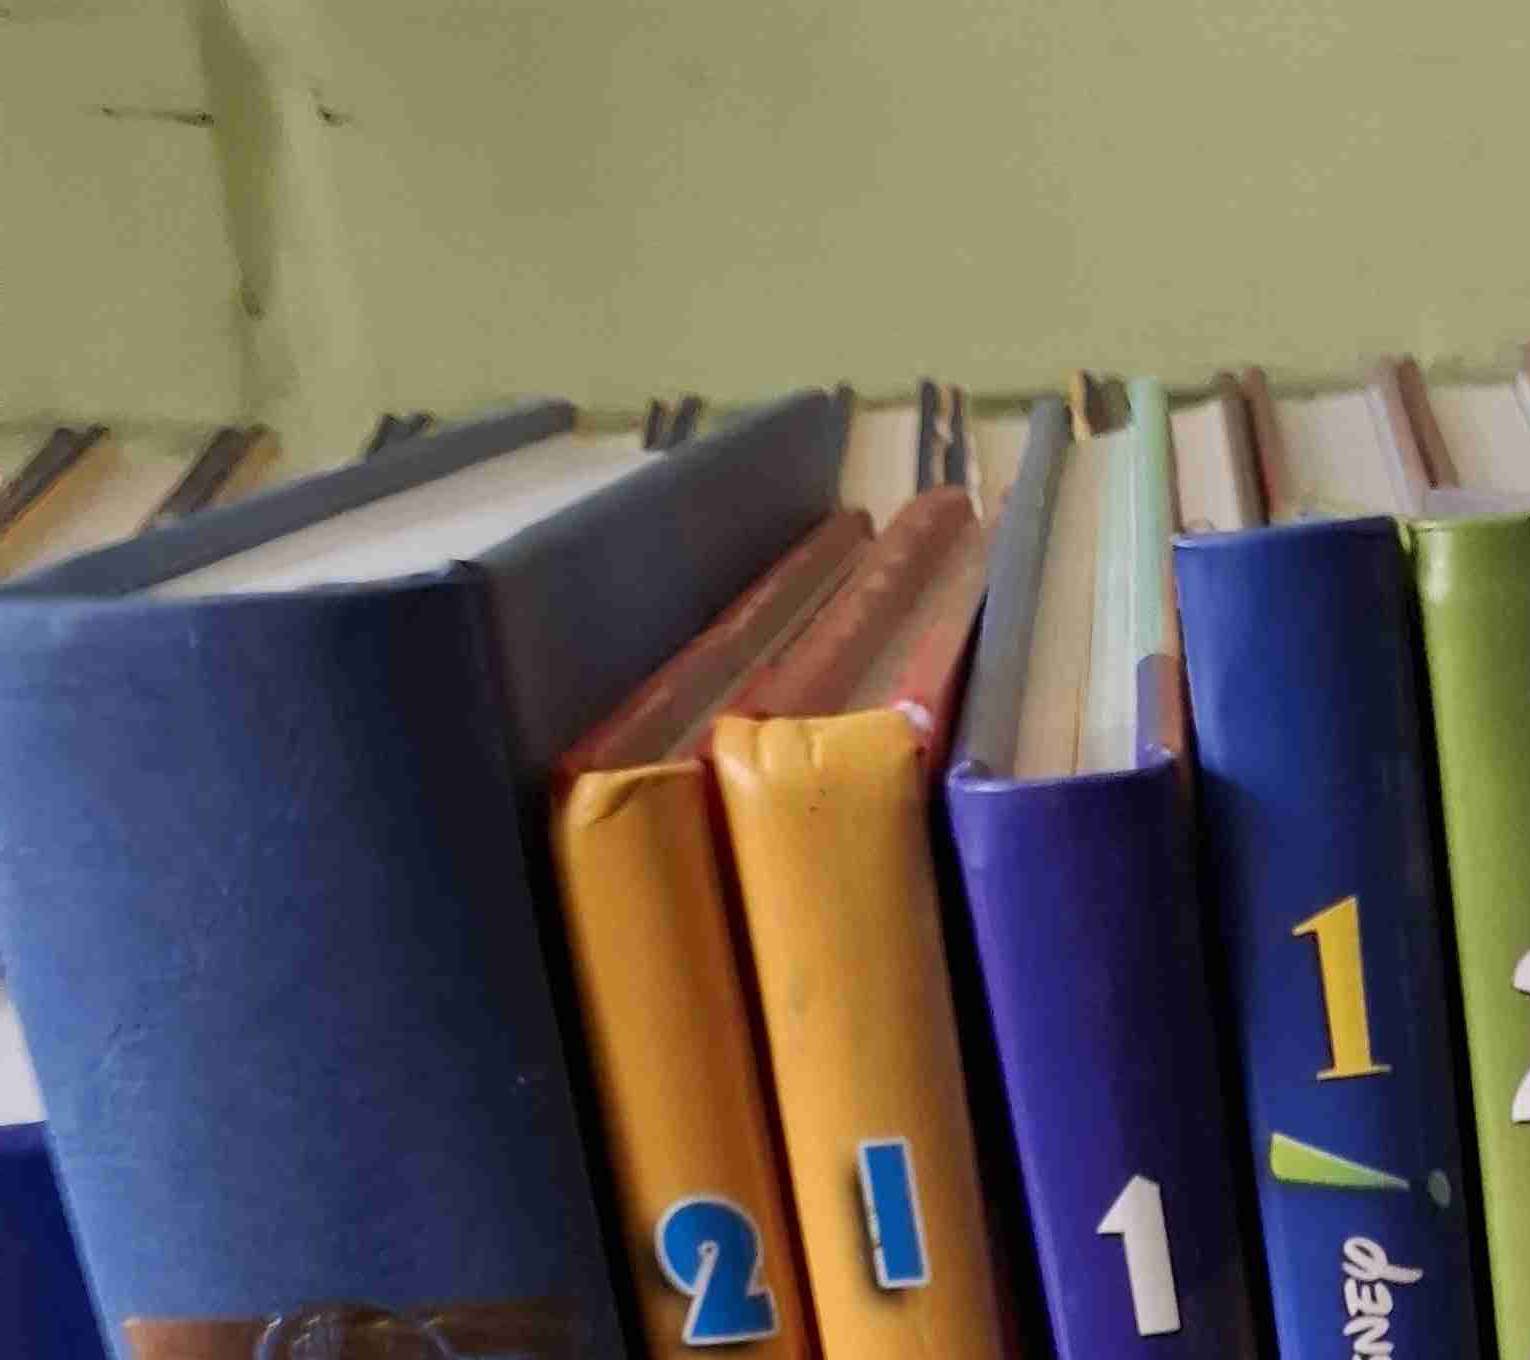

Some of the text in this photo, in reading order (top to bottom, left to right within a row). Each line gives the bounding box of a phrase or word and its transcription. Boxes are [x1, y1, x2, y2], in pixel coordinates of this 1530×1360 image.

[1292, 895, 1391, 1080] 1
[655, 1193, 781, 1347] 2
[1096, 1173, 1184, 1336] 1
